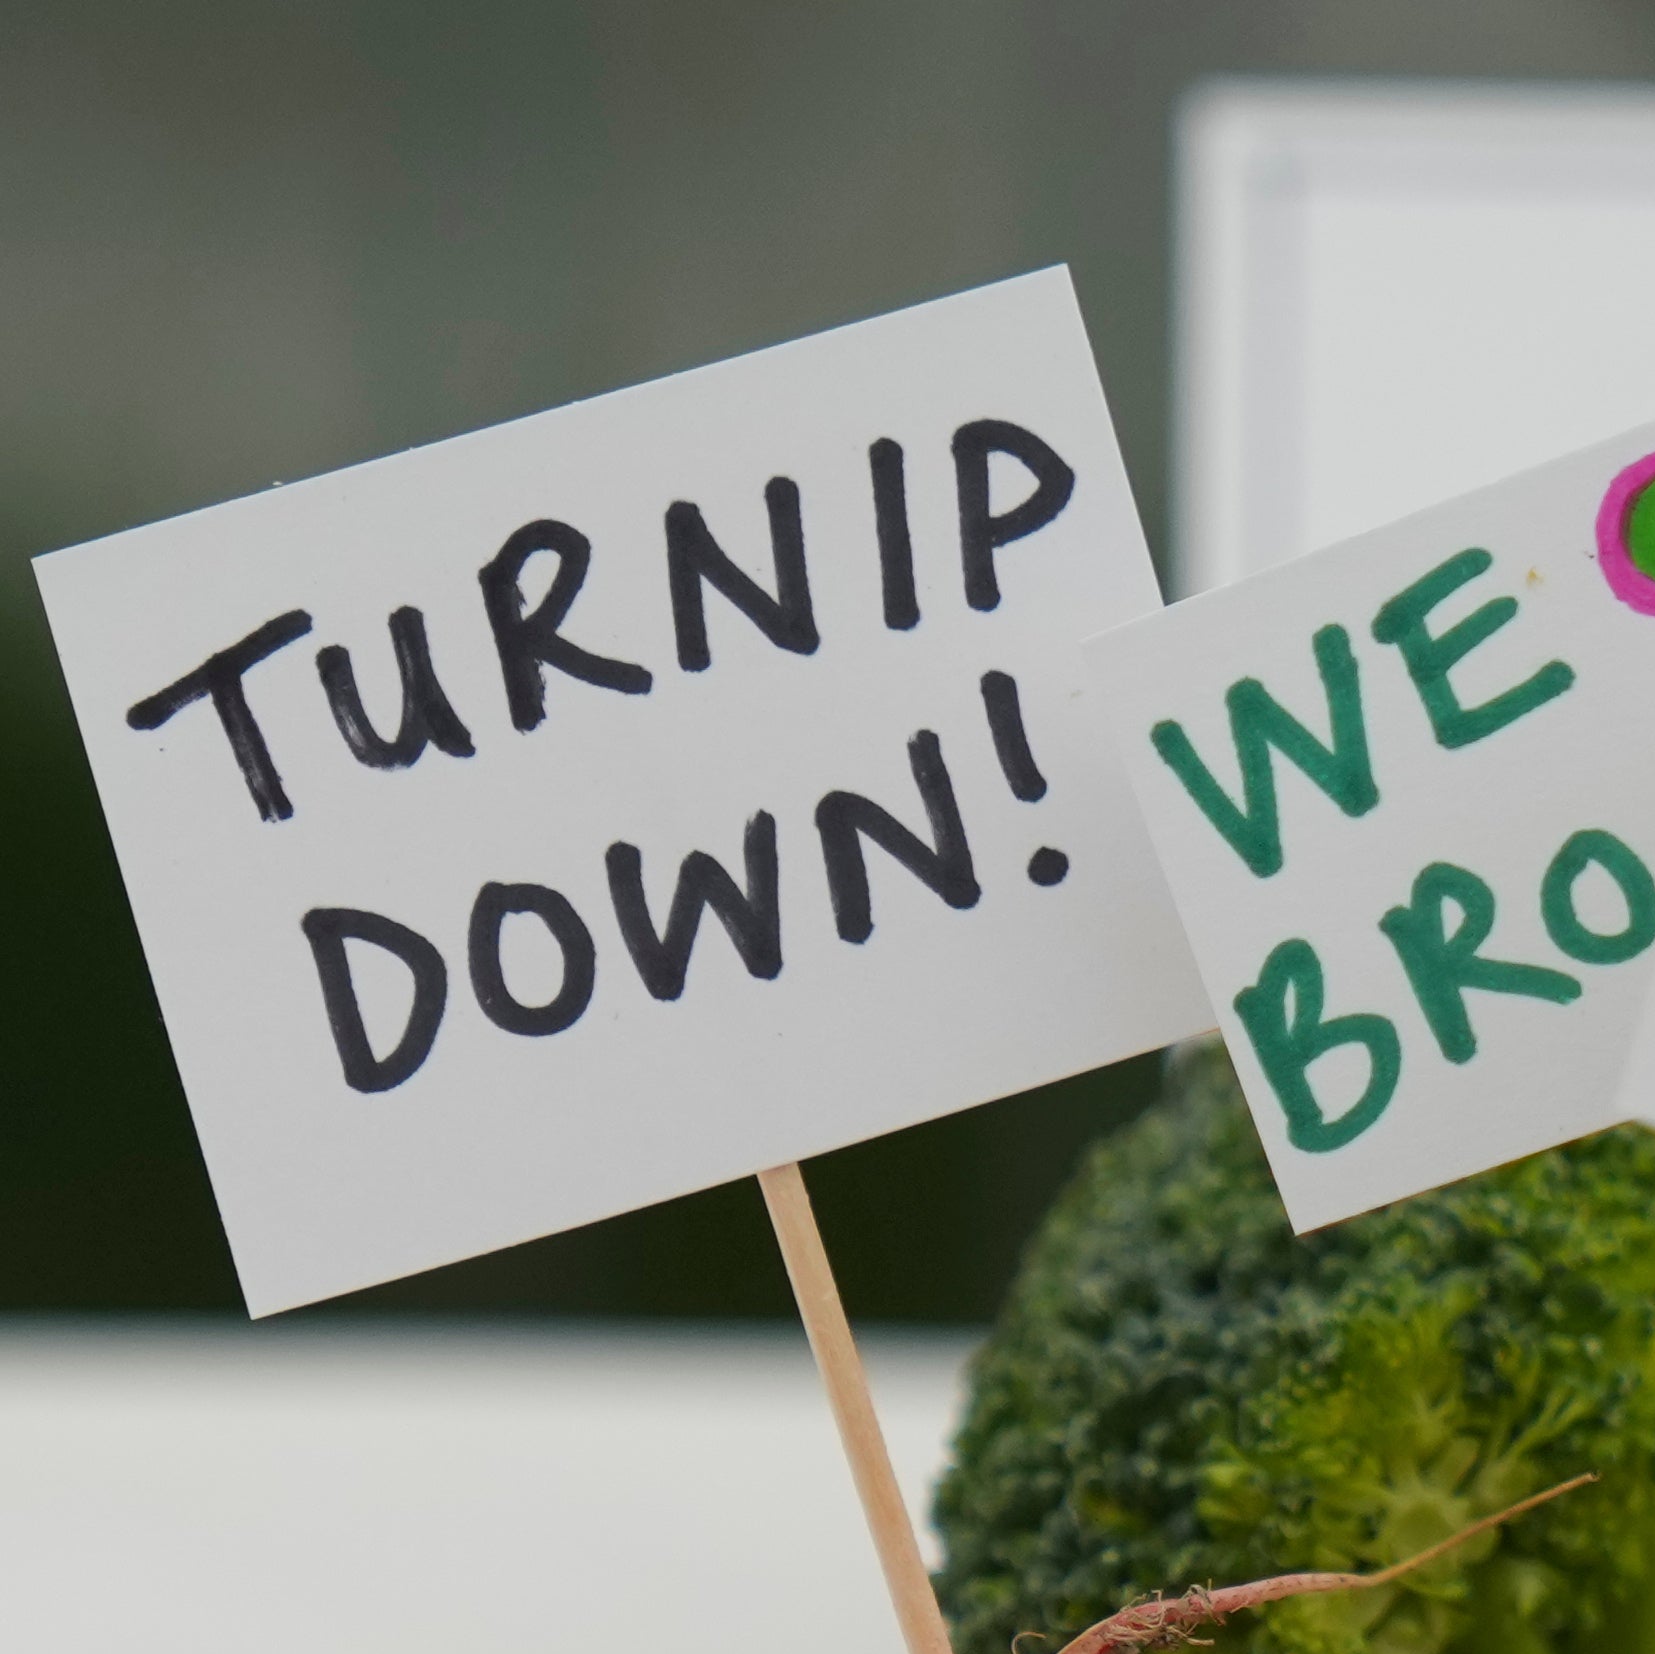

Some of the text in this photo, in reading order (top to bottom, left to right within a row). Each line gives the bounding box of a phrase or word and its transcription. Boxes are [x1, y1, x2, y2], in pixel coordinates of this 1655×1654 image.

[124, 417, 1077, 824] TURNIP
[1148, 545, 1578, 879] WE
[300, 668, 1071, 1095] DOWN!
